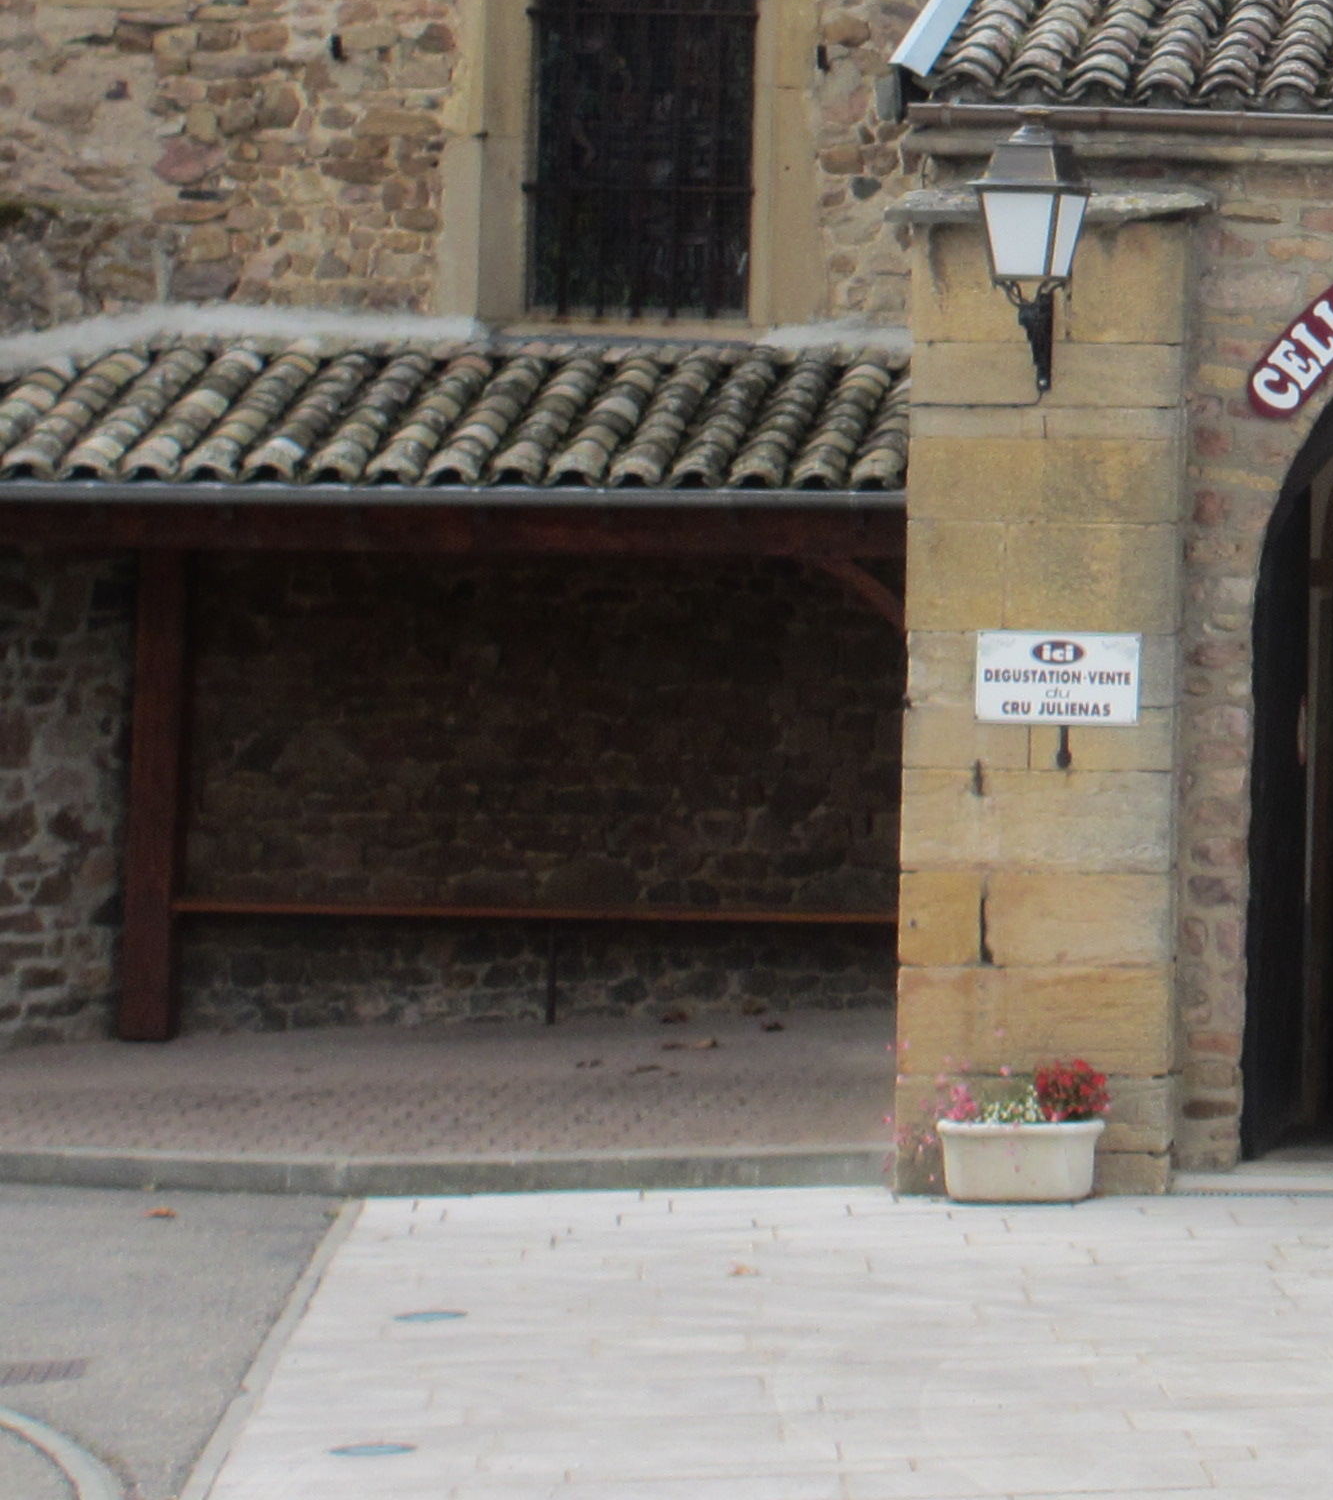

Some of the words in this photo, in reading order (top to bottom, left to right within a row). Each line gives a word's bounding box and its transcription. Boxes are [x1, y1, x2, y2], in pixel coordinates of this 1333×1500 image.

[1042, 644, 1074, 661] ici
[1045, 687, 1070, 699] du
[1002, 701, 1031, 715] CRU
[1038, 702, 1111, 716] JULIENAS
